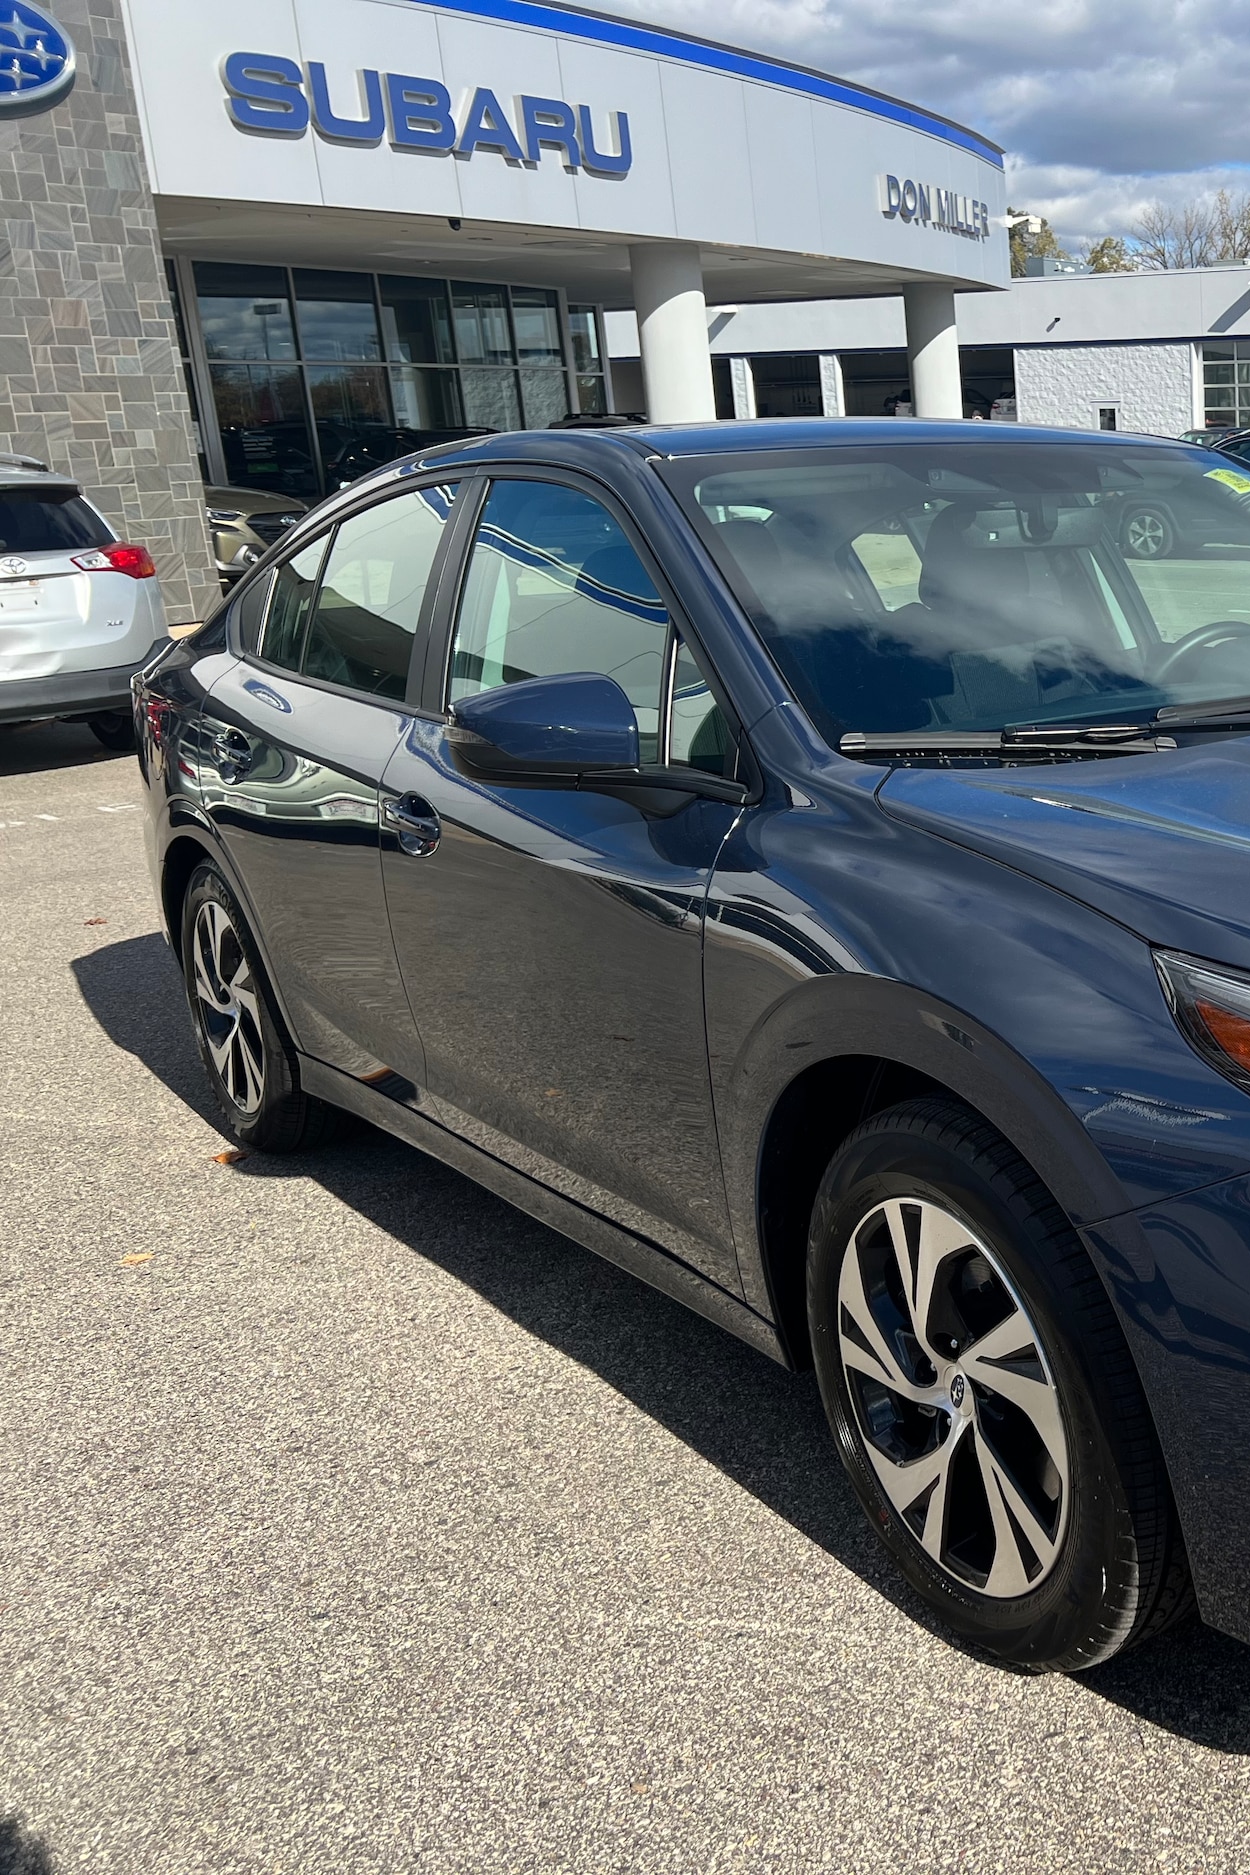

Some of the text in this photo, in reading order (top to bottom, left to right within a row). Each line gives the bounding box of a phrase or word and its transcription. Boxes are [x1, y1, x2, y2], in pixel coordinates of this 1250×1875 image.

[222, 51, 632, 175] SUBARU
[882, 174, 990, 237] DON MILLER
